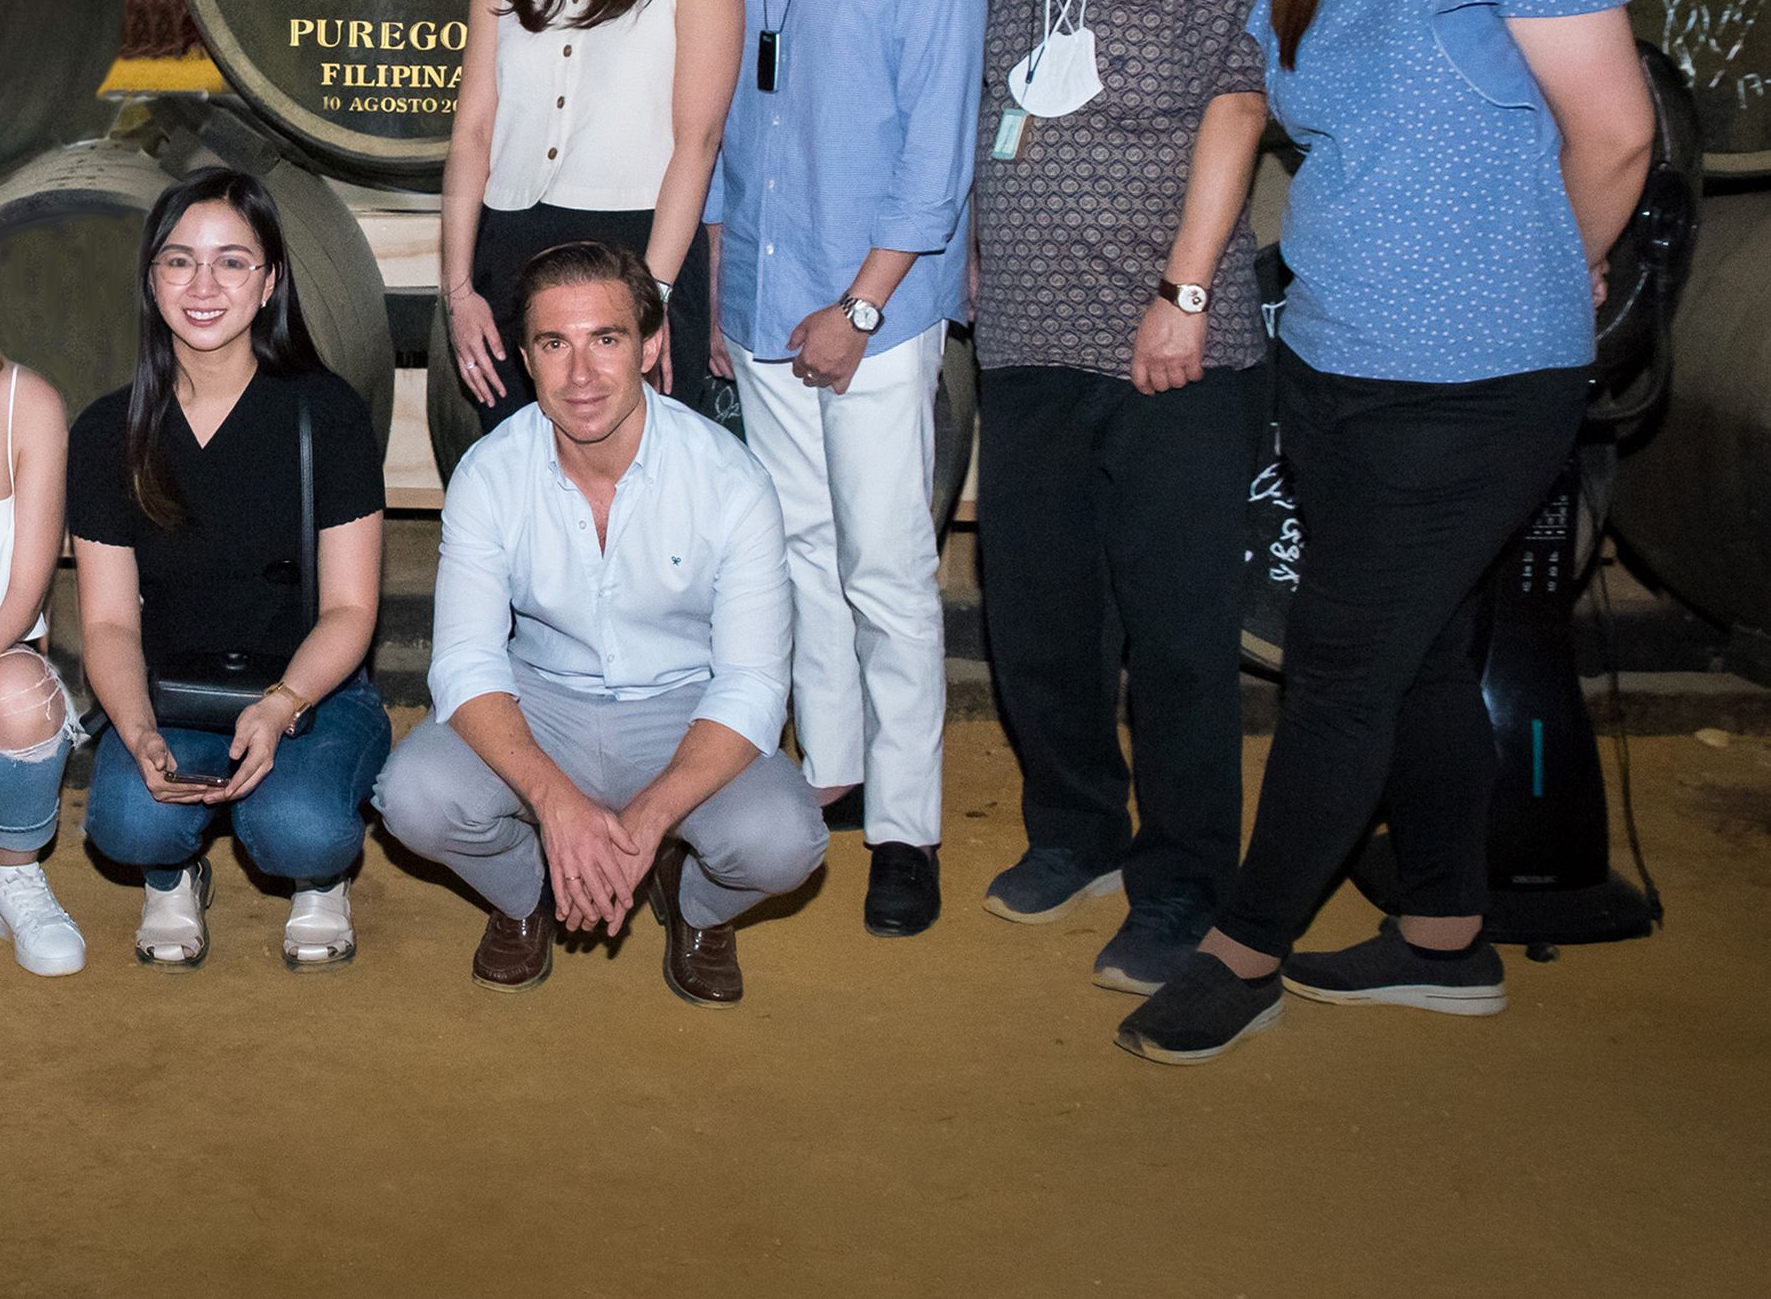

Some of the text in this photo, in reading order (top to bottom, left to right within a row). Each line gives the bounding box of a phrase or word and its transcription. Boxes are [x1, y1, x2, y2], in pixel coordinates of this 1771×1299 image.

[290, 19, 468, 50] PUREGO
[321, 63, 462, 88] FILIPINA
[349, 97, 437, 113] AGOSTO
